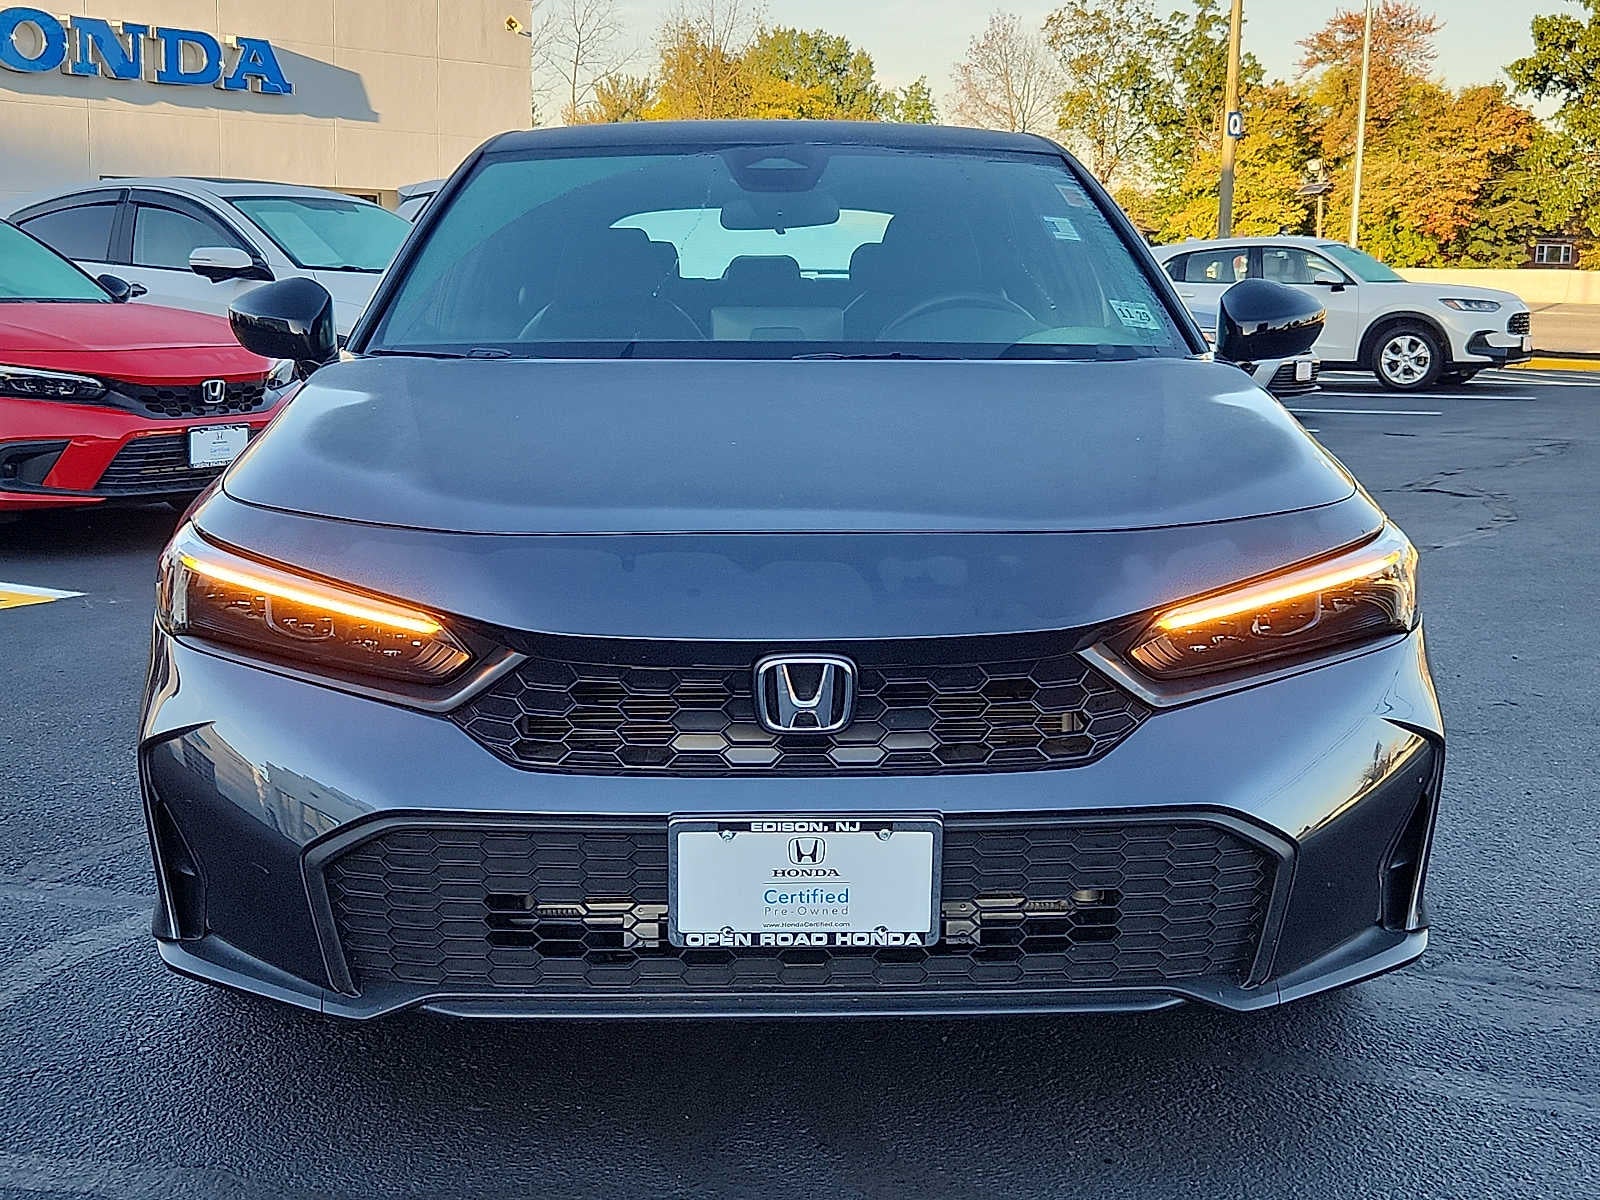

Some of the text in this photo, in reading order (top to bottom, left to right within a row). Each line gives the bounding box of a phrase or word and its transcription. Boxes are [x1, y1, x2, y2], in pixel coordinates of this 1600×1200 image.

[750, 822, 861, 833] EDISON, NJ
[772, 868, 841, 878] HONDA
[763, 887, 849, 904] Certified
[764, 906, 849, 916] Pre-Owned
[762, 920, 850, 928] www.HondaCertified.com
[685, 931, 923, 947] OPEN ROAD HONDA
